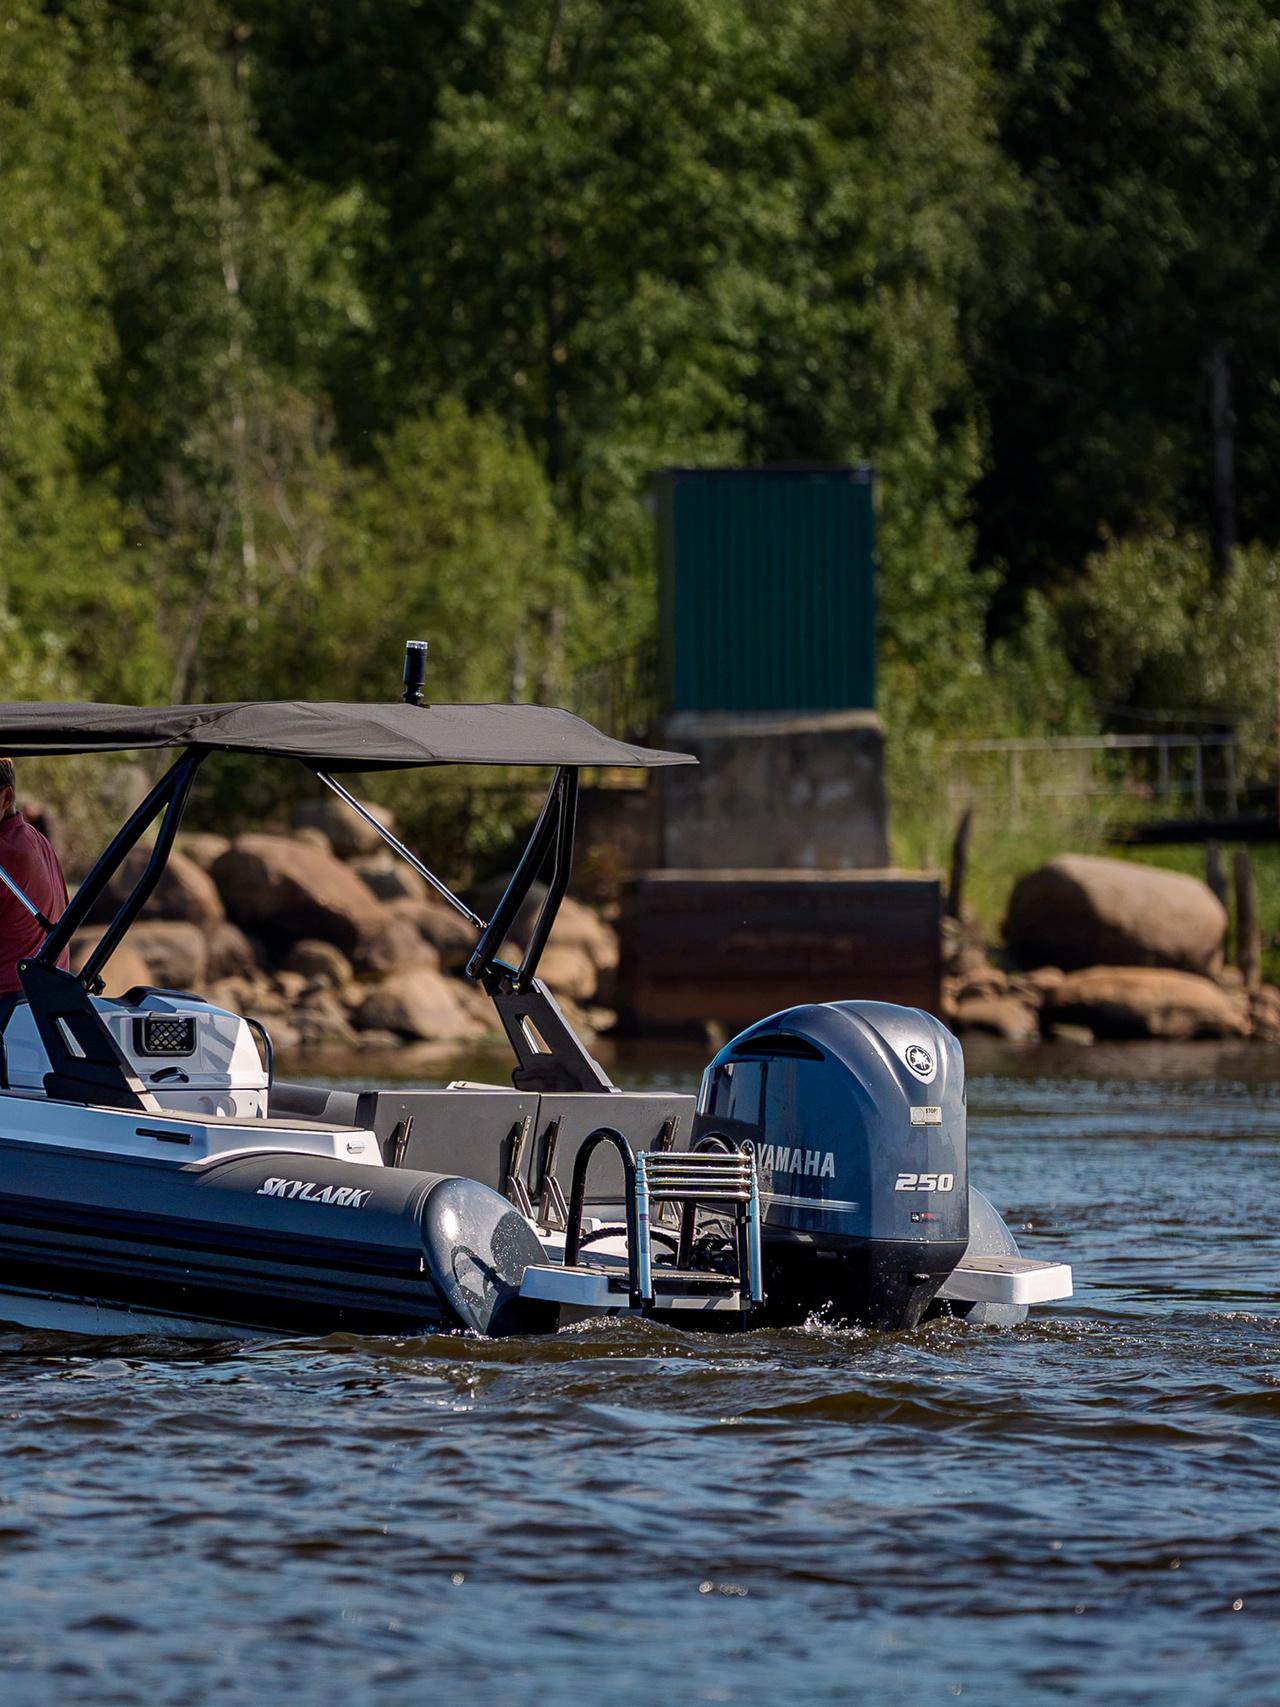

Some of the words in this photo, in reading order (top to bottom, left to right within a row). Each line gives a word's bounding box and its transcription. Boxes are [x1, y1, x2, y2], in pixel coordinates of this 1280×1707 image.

[757, 1143, 835, 1178] YAMAHA
[256, 1177, 372, 1208] SKYLARK
[894, 1173, 954, 1192] 250
